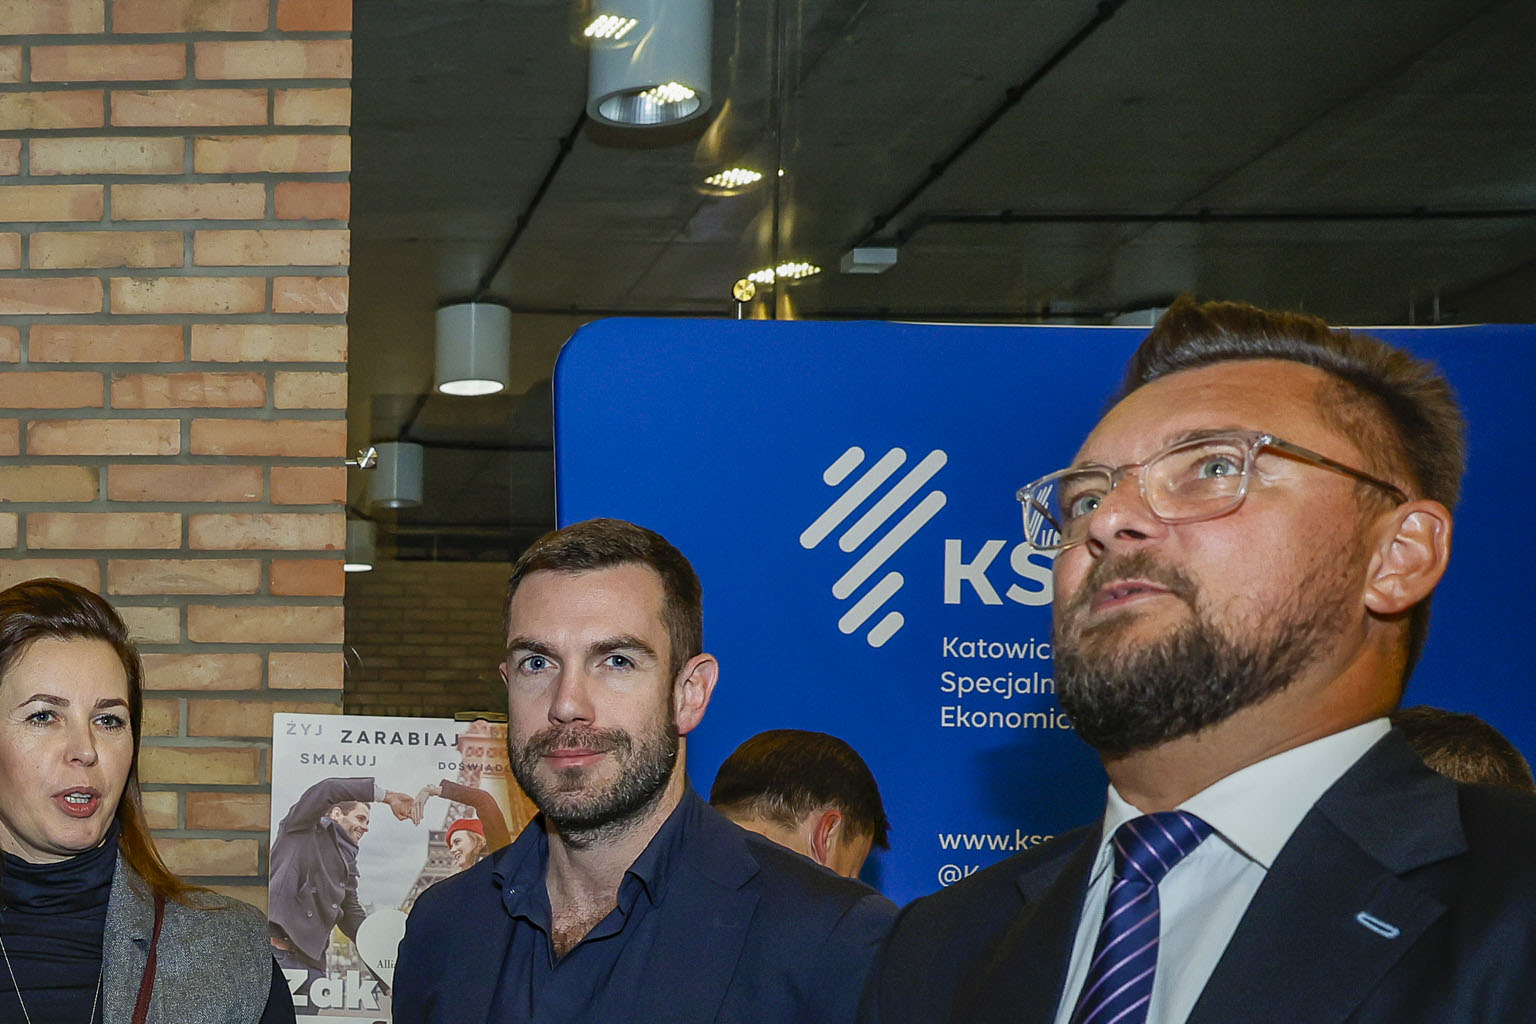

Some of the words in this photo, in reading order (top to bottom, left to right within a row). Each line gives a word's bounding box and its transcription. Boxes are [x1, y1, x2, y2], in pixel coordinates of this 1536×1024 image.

[286, 720, 323, 736] ŻYJ
[341, 729, 460, 748] ZARABIAJ
[300, 752, 377, 767] SMAKUJ
